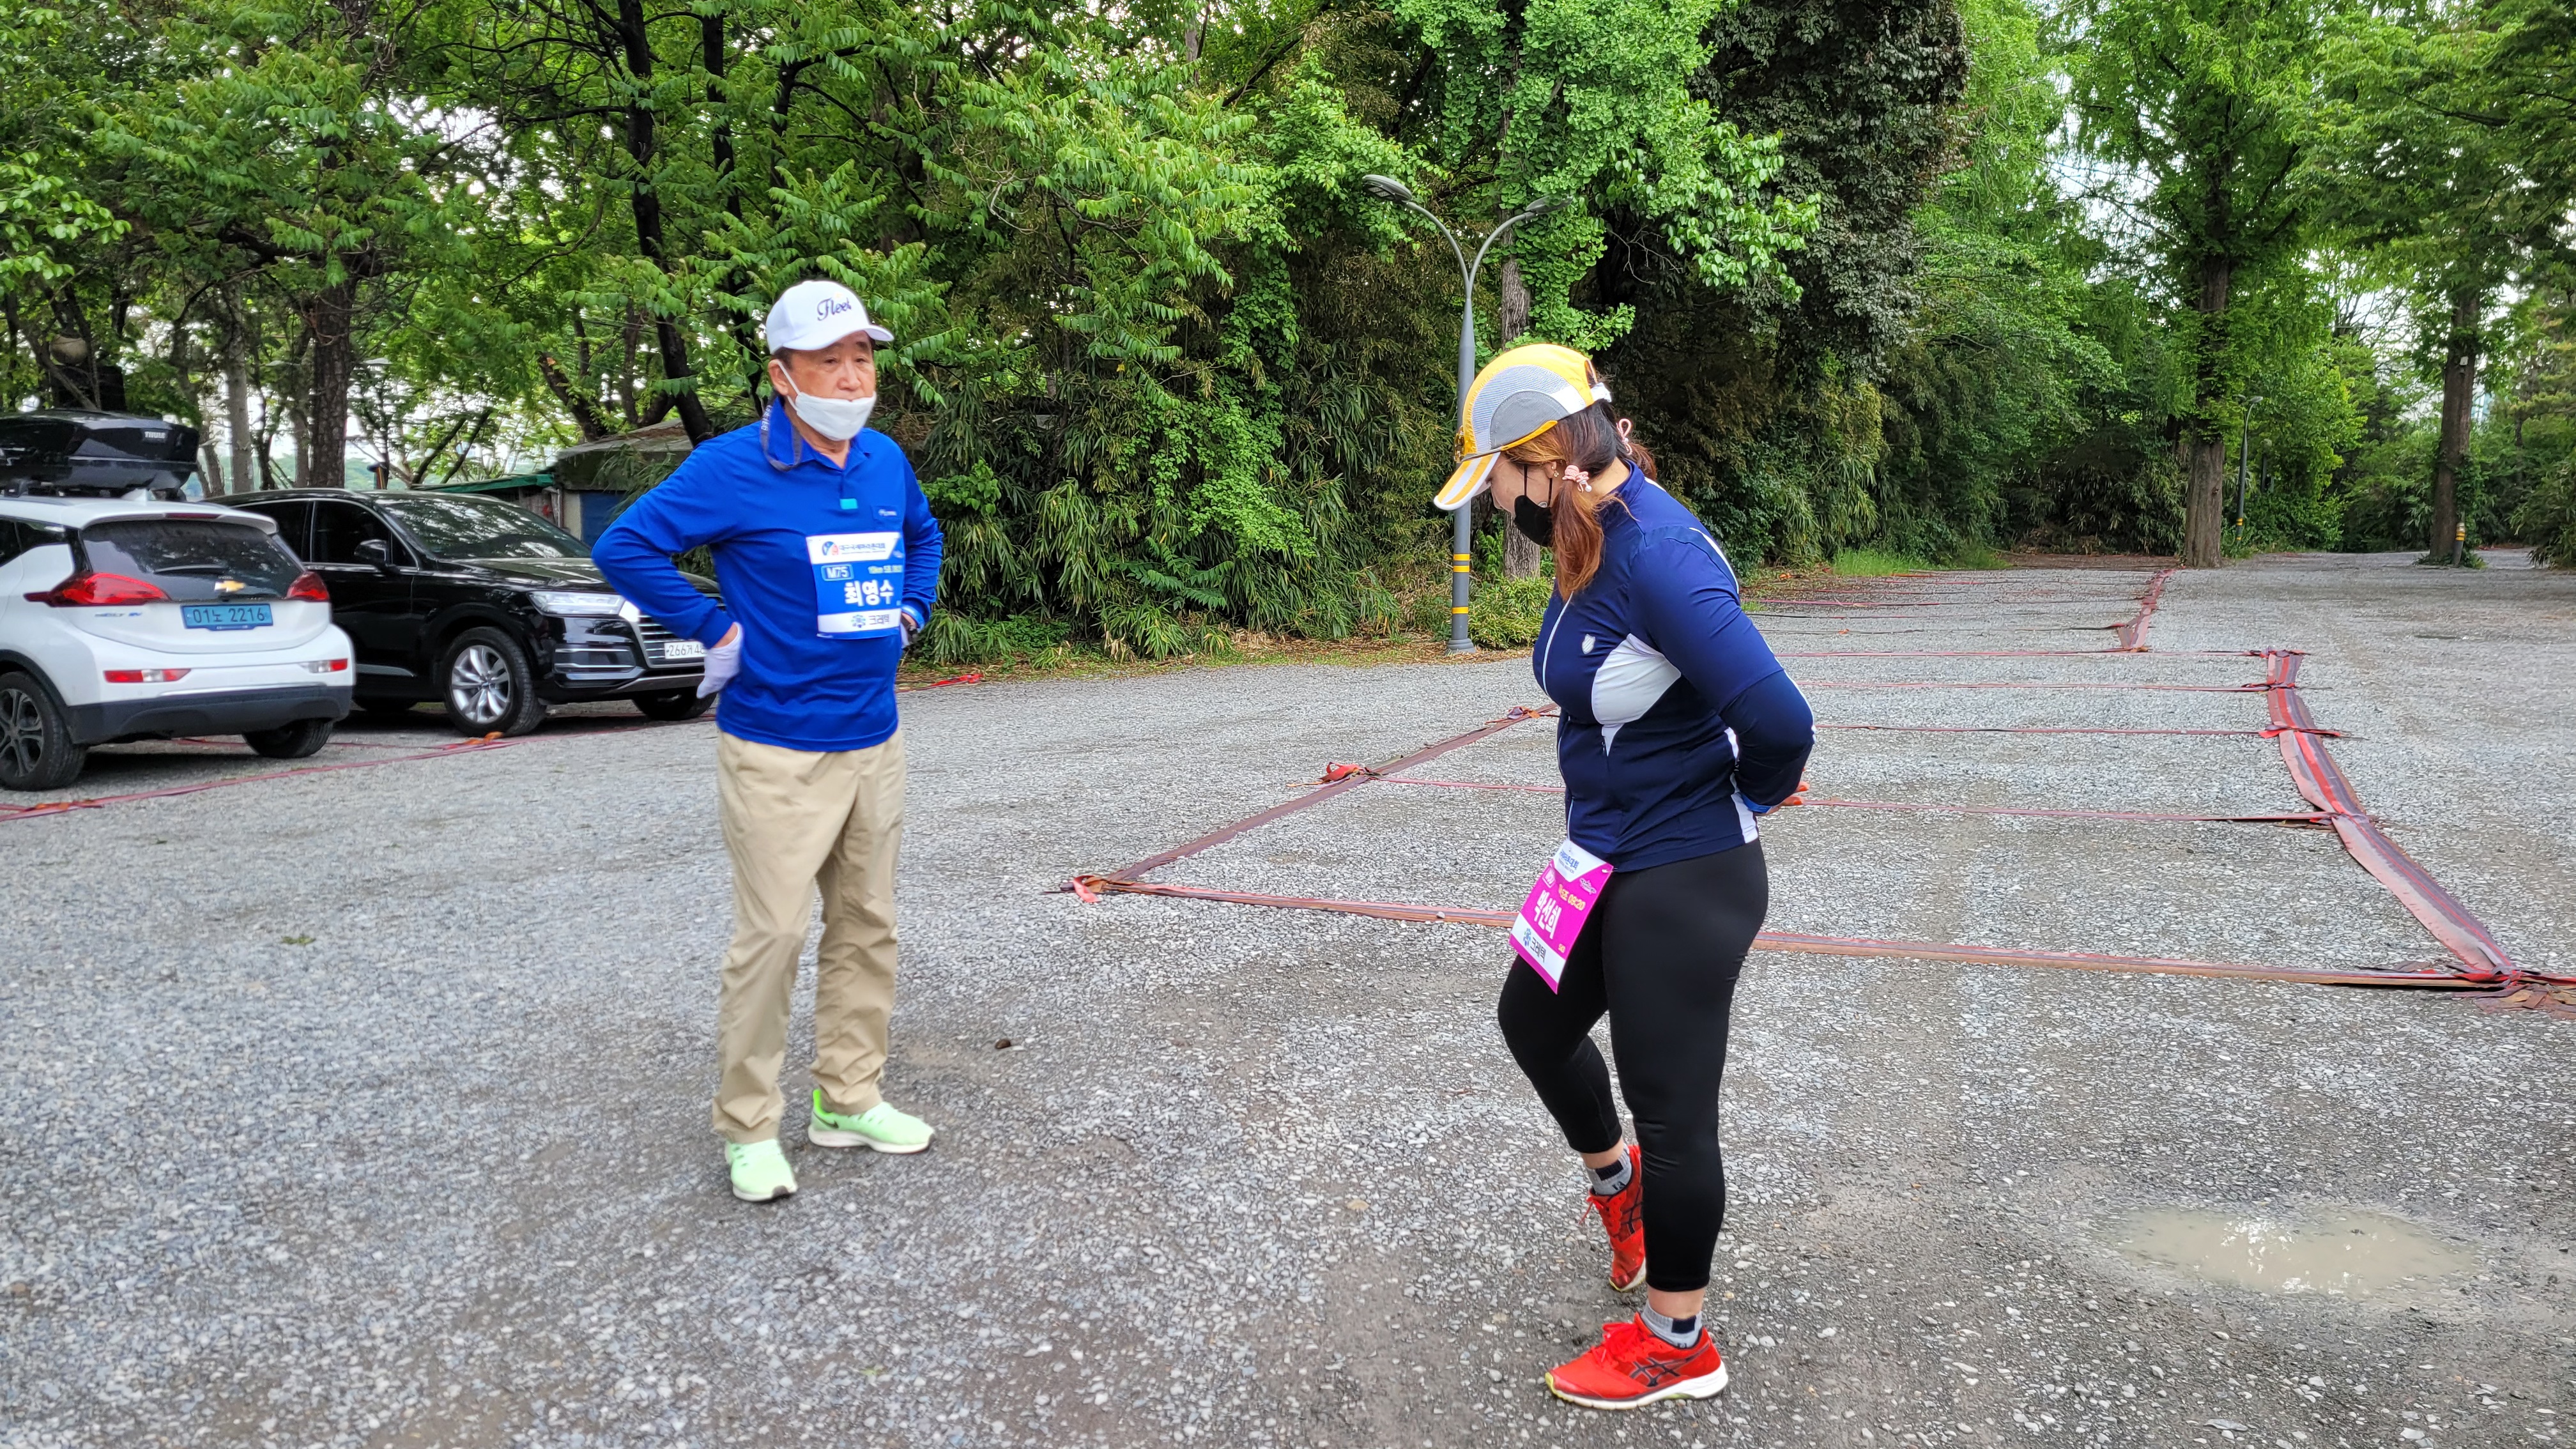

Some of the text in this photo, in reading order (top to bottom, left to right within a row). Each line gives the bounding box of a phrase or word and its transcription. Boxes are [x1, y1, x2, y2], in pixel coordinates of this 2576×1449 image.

[826, 567, 849, 578] M75
[844, 579, 894, 607] 최영수
[193, 608, 264, 623] 01노 2216
[1534, 889, 1562, 940] 박선희
